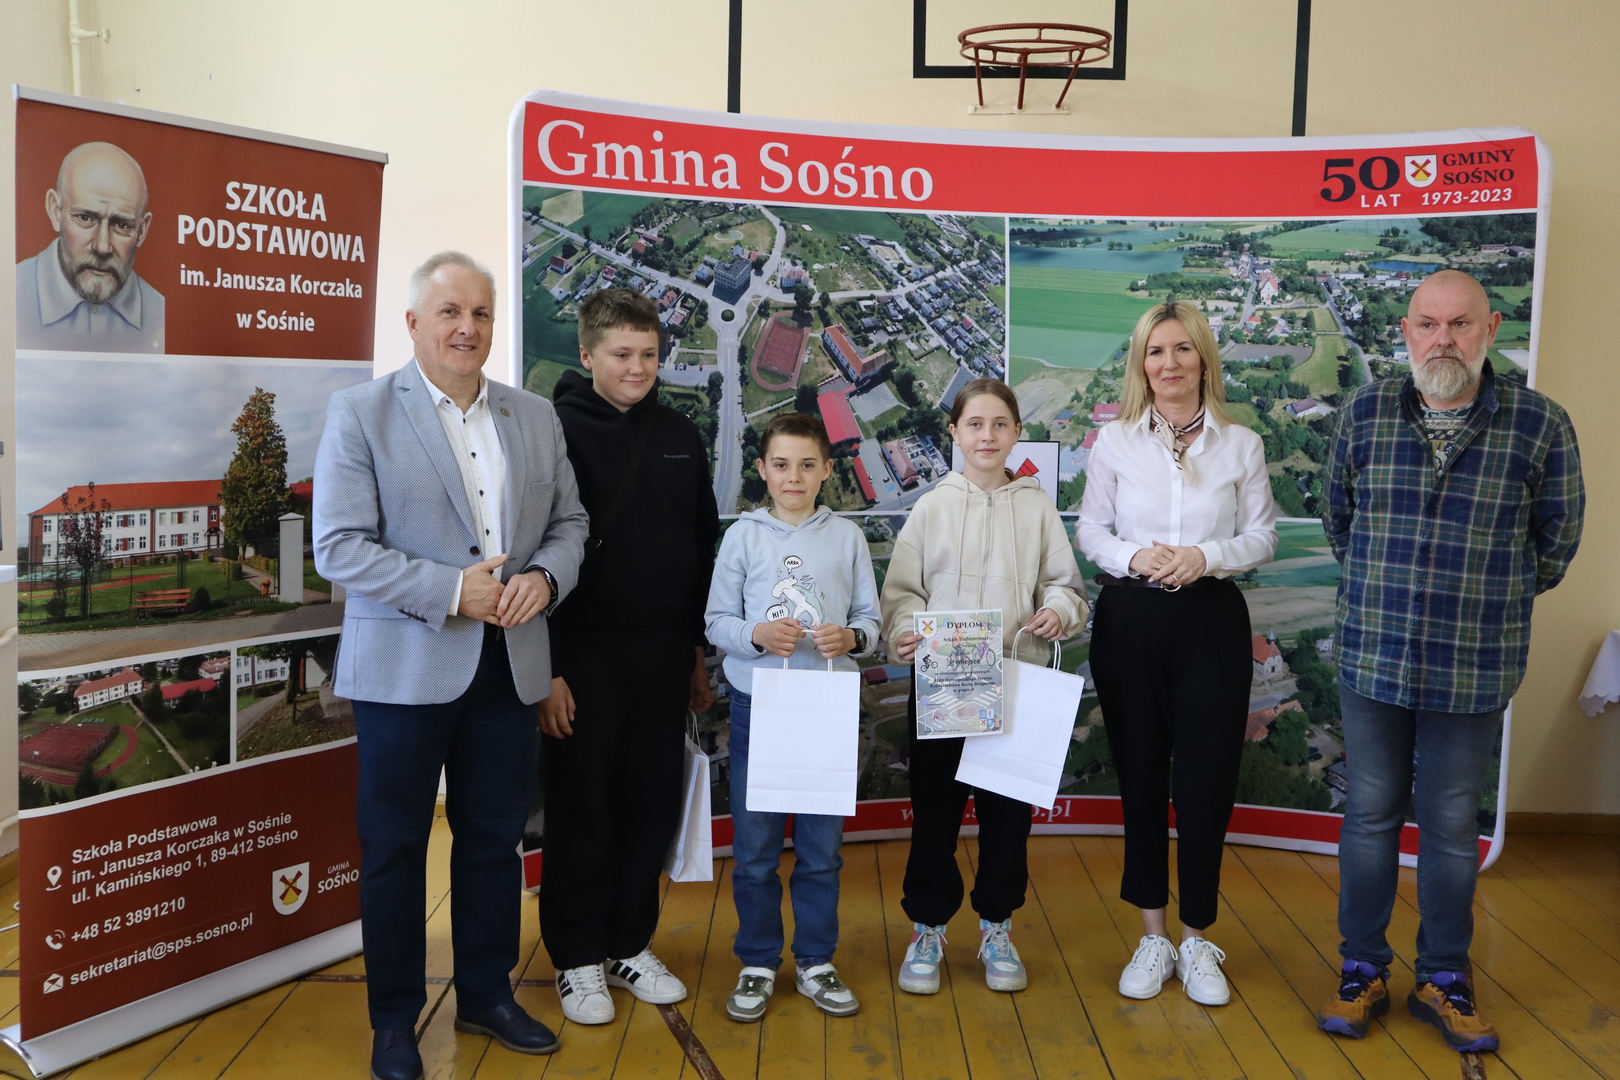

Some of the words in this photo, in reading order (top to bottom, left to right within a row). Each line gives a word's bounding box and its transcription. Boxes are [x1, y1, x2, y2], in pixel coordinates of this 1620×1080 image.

[537, 119, 740, 190] Gmina
[759, 141, 934, 201] Sośno
[1443, 149, 1515, 167] GMINY
[1443, 167, 1515, 185] SOŚNO
[1320, 156, 1400, 202] 50
[1421, 188, 1513, 206] 1973-2023
[225, 181, 327, 222] SZKOŁA
[1361, 193, 1401, 208] LAT
[177, 214, 366, 263] PODSTAWOWA
[180, 263, 210, 287] im.
[213, 267, 286, 293] Janusza
[290, 274, 363, 298] Korczaka
[236, 313, 253, 328] w
[256, 309, 315, 332] Sośnie
[947, 621, 982, 629] DYPLOM
[72, 839, 123, 864] Szkoła
[127, 815, 217, 849] Podstawowa
[72, 869, 96, 885] im.
[99, 851, 162, 878] Janusza
[166, 829, 231, 858] Korczaka
[233, 825, 246, 838] w
[247, 811, 292, 834] Sośnie
[72, 886, 91, 905] ul.
[95, 860, 192, 897] Kamińskiego
[195, 853, 208, 869] 1,
[210, 838, 254, 864] 89-412
[256, 828, 299, 849] Sośno
[317, 869, 360, 894] SOŚNO
[327, 860, 350, 875] GMINA
[71, 923, 99, 943] +48
[103, 915, 122, 935] 52
[125, 896, 186, 929] 3891210
[70, 912, 254, 986] sekretariat@sps.sosno.pl
